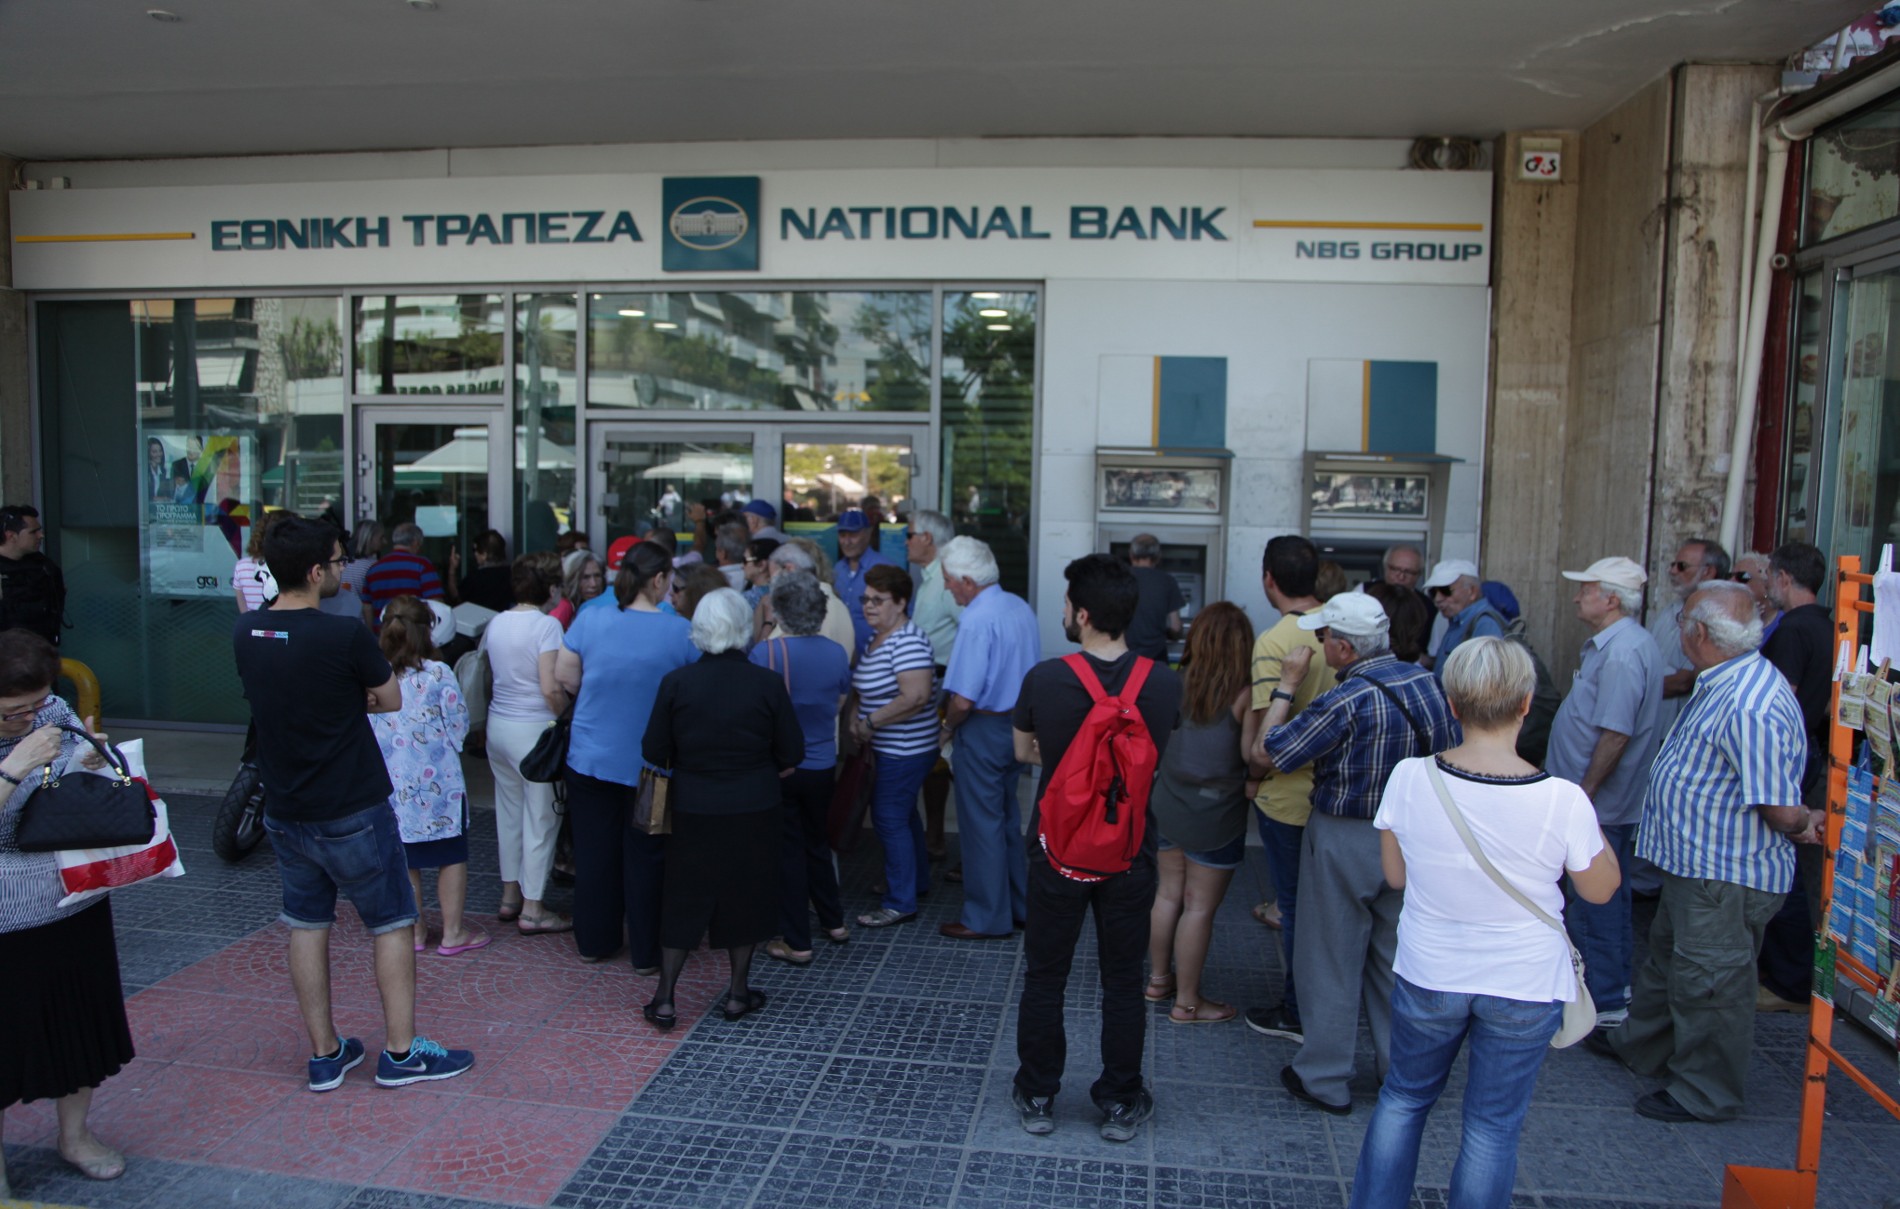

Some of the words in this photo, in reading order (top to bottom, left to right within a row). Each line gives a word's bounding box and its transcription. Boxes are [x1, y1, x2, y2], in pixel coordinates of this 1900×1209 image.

[211, 216, 389, 251] ΕΘΝΙΚΗ
[403, 210, 642, 245] ΤΡΑΠΕΖΑ
[780, 206, 1050, 239] NATIONAL
[1070, 206, 1227, 240] BANK
[1296, 241, 1360, 259] NBG
[1371, 242, 1482, 261] GROUP
